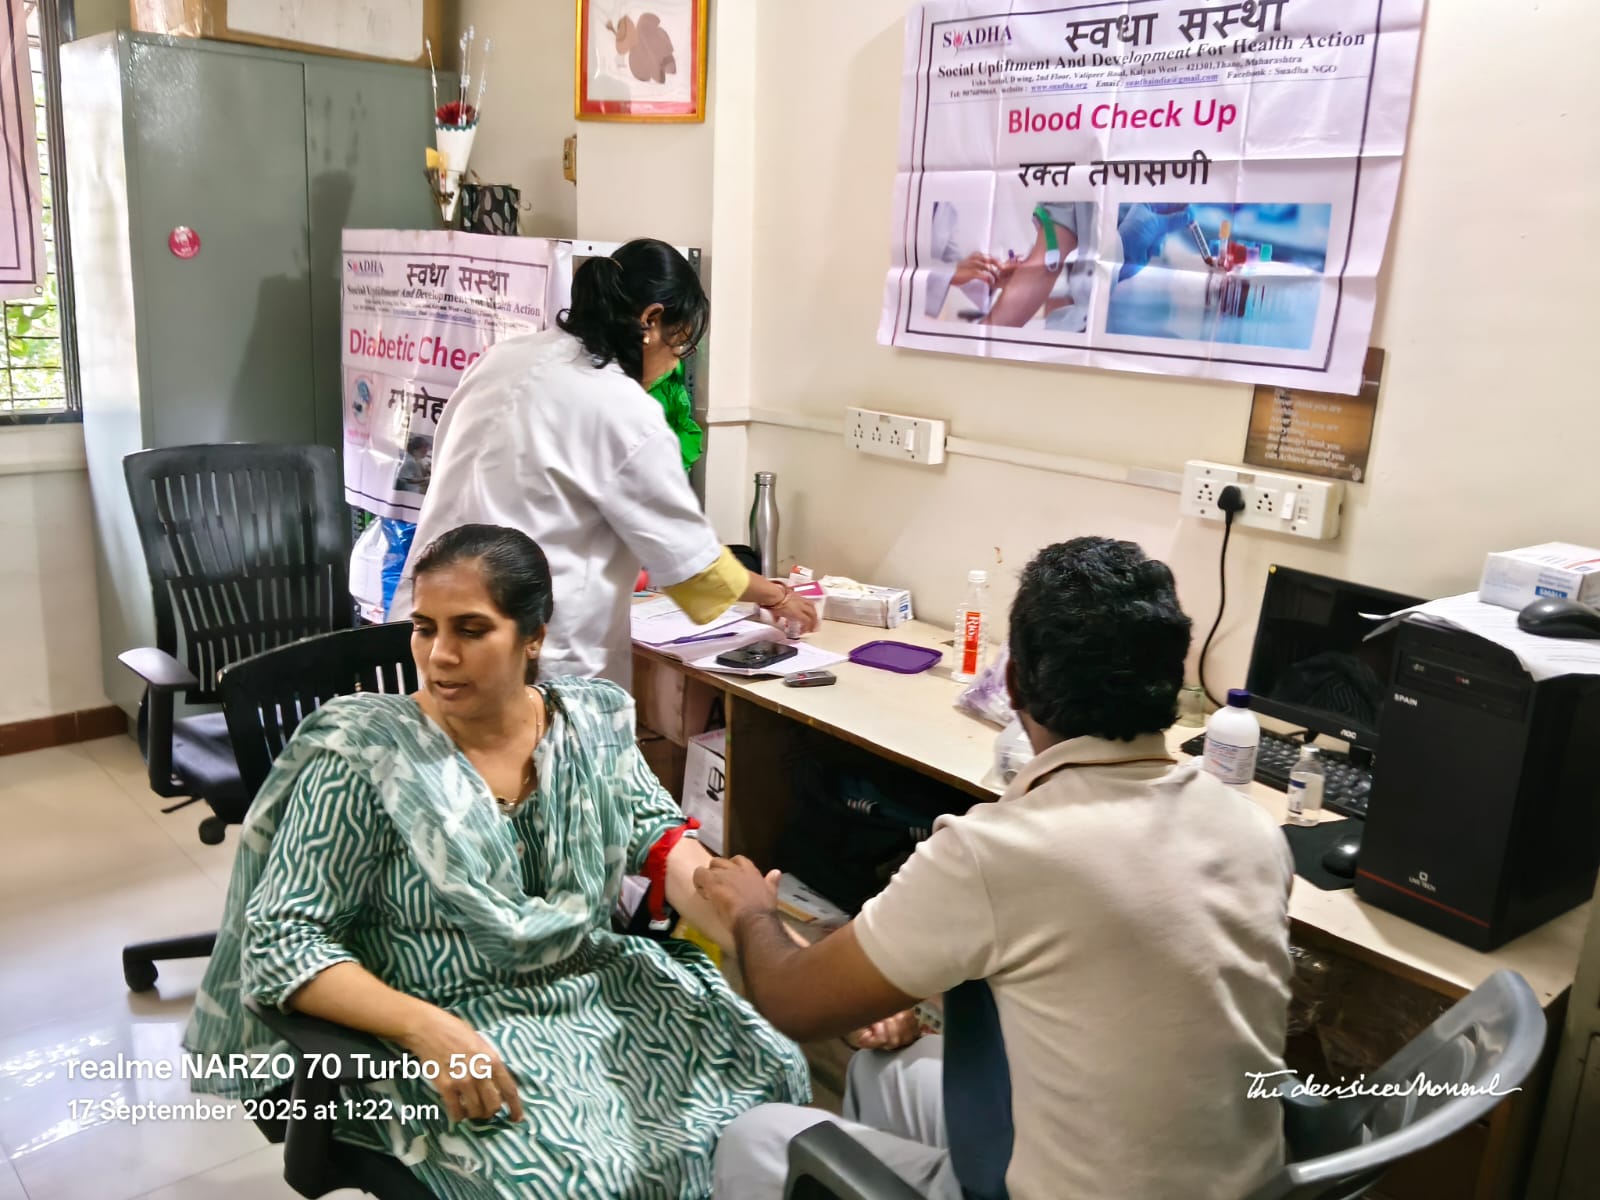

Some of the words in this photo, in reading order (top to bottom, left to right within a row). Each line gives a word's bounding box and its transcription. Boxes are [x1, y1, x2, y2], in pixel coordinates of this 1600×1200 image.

[1065, 12, 1158, 51] स्वधा
[1179, 0, 1289, 42] सस्था
[938, 64, 974, 78] Social
[979, 57, 1049, 76] Upliftment
[1055, 54, 1086, 69] And
[1092, 47, 1191, 66] Development
[1197, 43, 1226, 57] For
[1233, 35, 1293, 53] Health
[1300, 31, 1365, 49] Action
[1130, 66, 1156, 76] Kalyan
[1159, 65, 1177, 73] West
[1312, 64, 1338, 74] NGO
[1008, 104, 1082, 133] Blood
[1091, 99, 1183, 129] Check
[1194, 98, 1237, 132] Up
[1018, 161, 1076, 187] रक्त
[1089, 149, 1212, 187] तपासणी
[406, 263, 449, 287] स्वधा
[513, 303, 541, 317] Action
[350, 328, 415, 362] Diabetic
[1394, 693, 1418, 706] SPAIN
[1340, 729, 1357, 740] AOC
